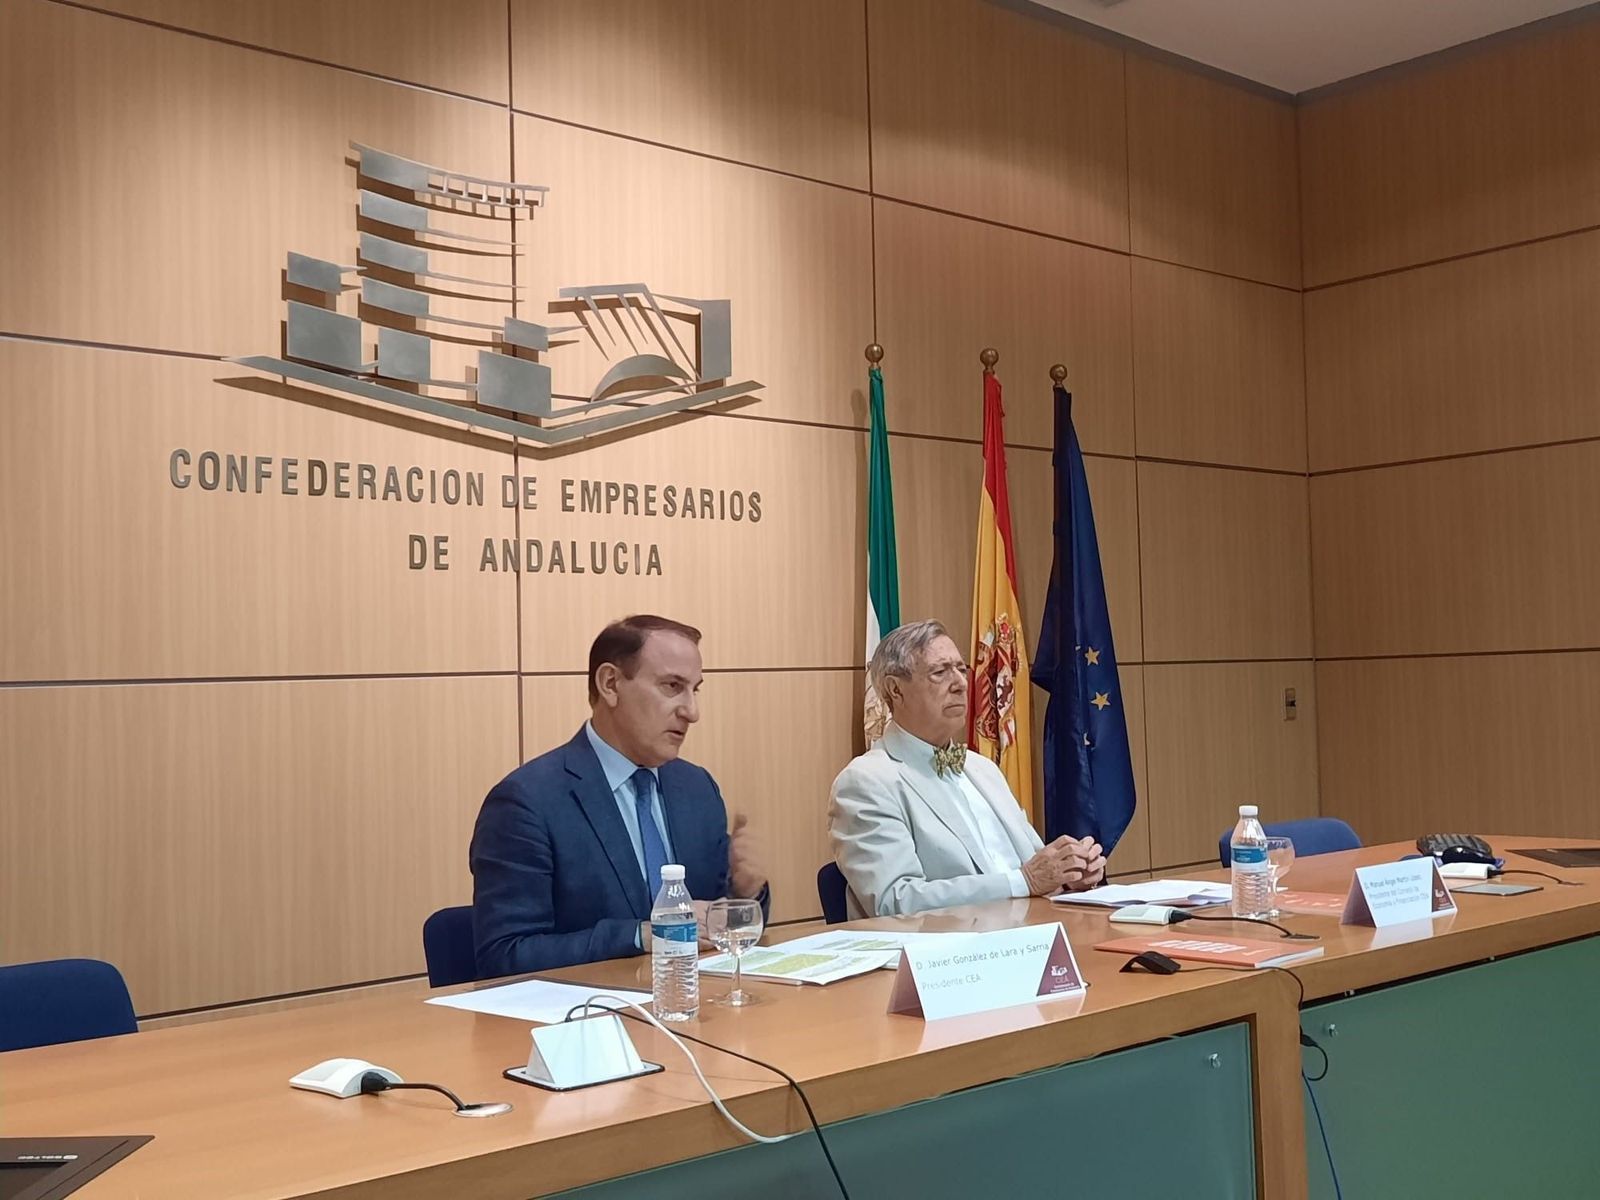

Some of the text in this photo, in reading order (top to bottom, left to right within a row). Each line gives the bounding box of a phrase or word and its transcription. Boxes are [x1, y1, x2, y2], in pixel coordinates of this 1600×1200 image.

[170, 448, 763, 523] CONFEDERACION DE EMPRESARIOS
[408, 534, 663, 576] DE ANDALUCIA
[927, 957, 951, 969] Javier
[965, 973, 982, 985] CEA
